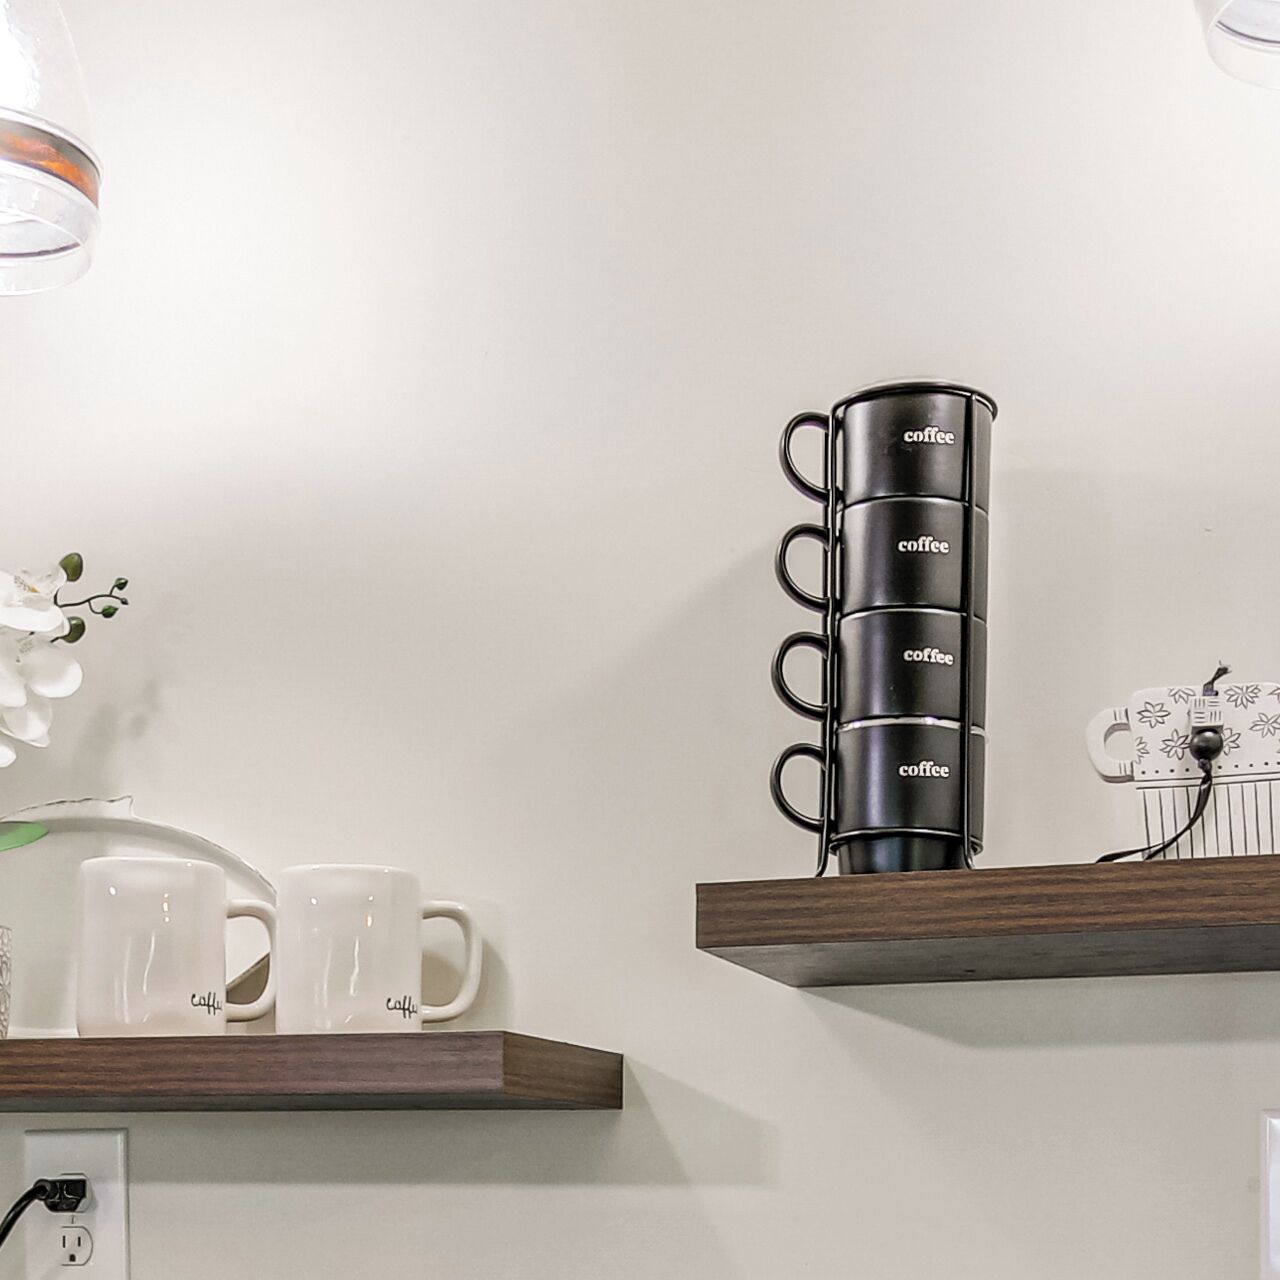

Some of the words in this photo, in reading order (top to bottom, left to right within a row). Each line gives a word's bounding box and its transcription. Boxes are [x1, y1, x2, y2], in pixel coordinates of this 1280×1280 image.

[903, 428, 954, 445] coffee
[897, 536, 949, 554] coffee
[903, 648, 953, 666] coffee
[898, 761, 949, 779] coffee
